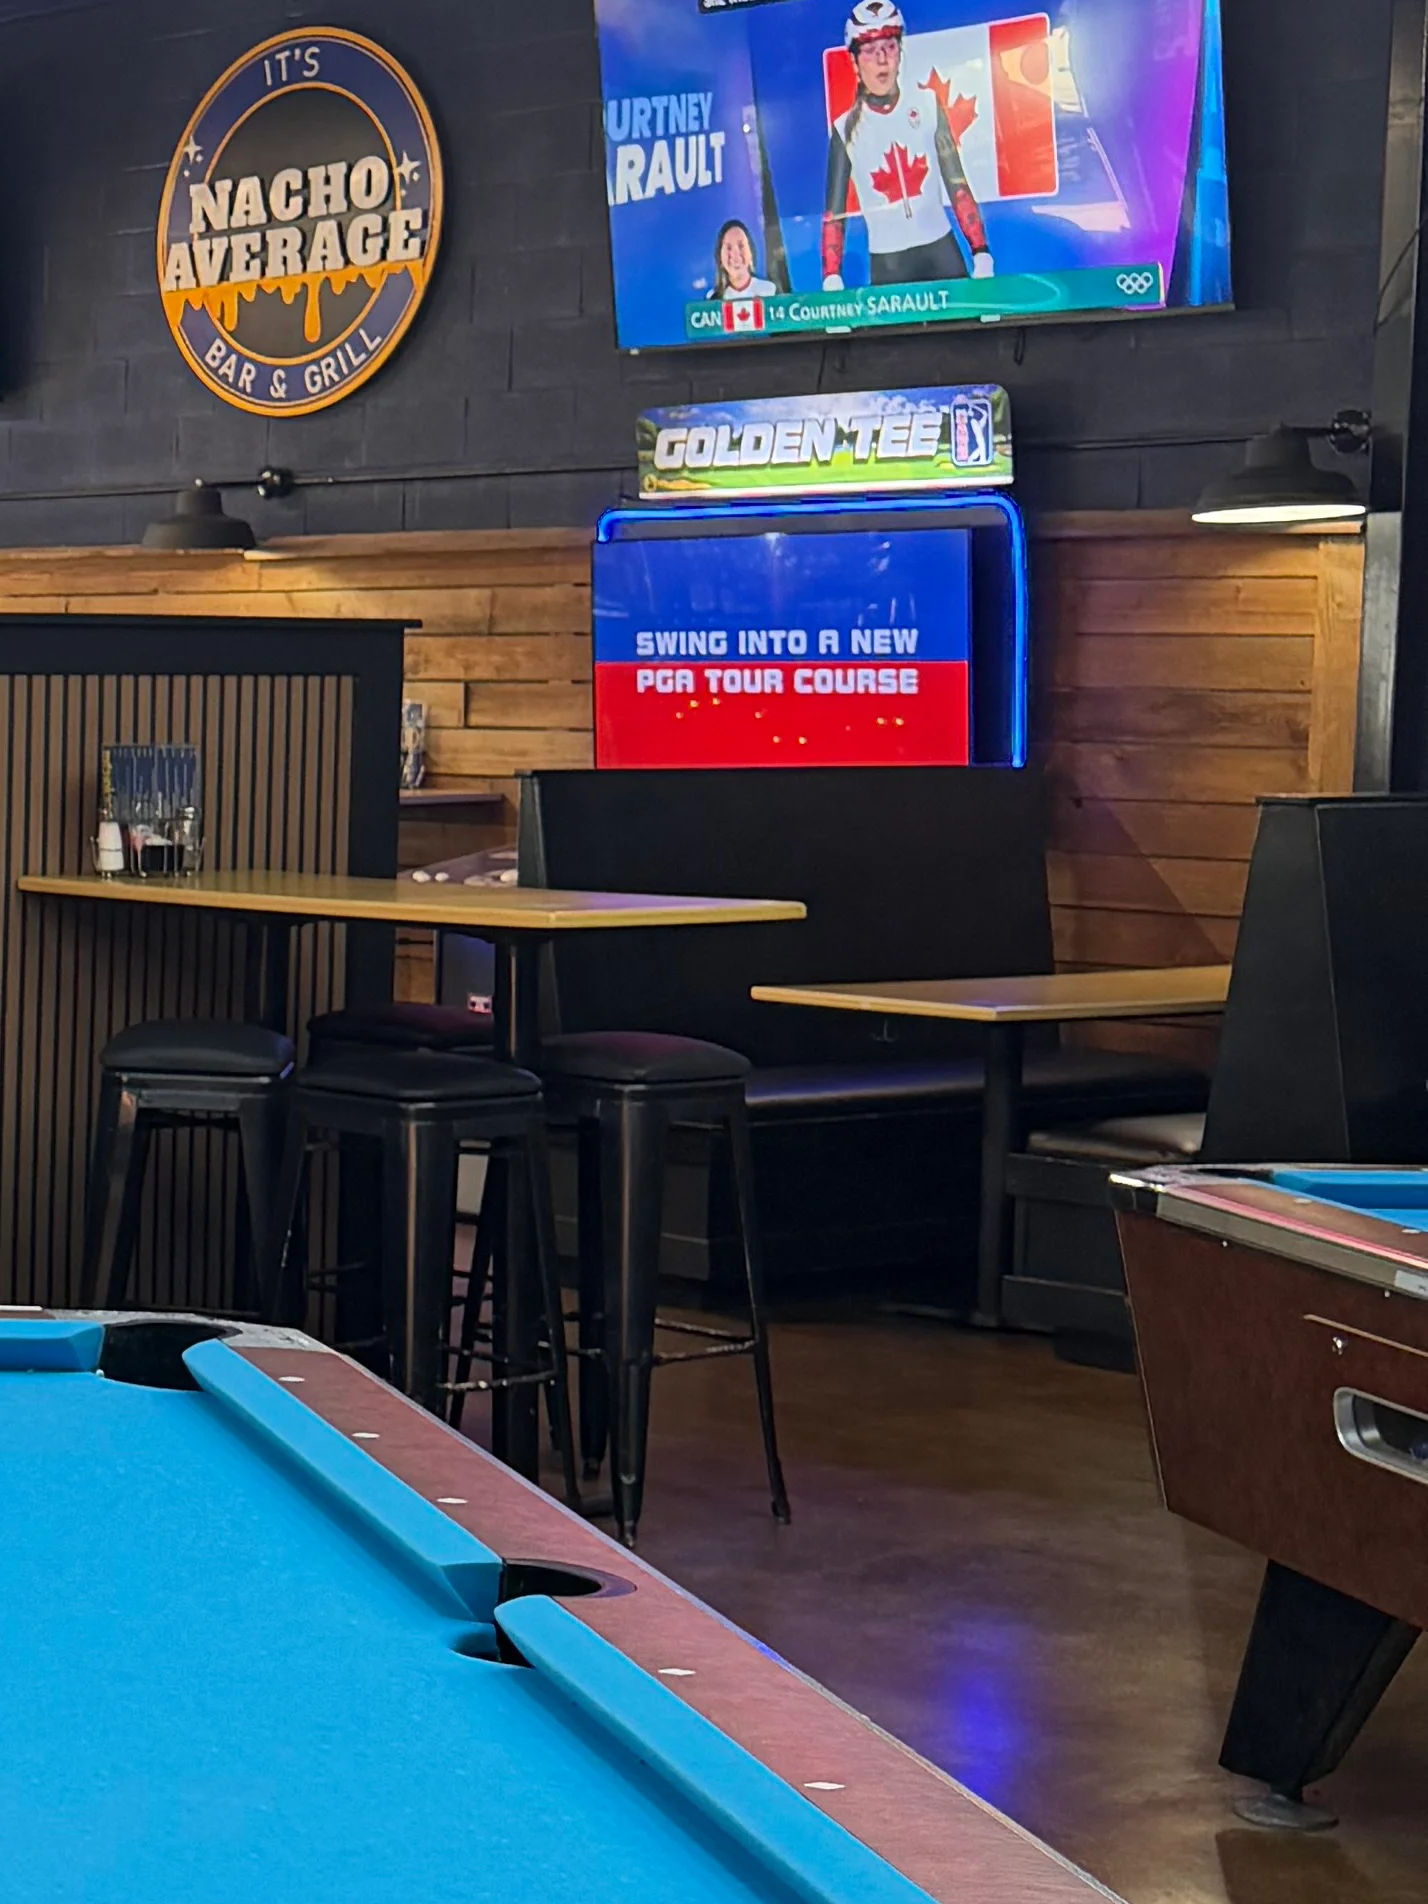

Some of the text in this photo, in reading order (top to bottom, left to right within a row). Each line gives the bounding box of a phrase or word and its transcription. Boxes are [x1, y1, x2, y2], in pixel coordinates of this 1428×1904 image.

[264, 46, 320, 86] IT'S
[190, 154, 389, 234] NACHO
[163, 207, 423, 292] AVERAGE
[690, 309, 723, 329] CAN
[768, 306, 785, 321] 14
[866, 290, 949, 315] SARAULT
[205, 327, 383, 399] BAR & GRILL
[654, 416, 836, 470] GOLDEN
[846, 411, 942, 462] TEE
[636, 628, 919, 656] SWING INTO A NEW
[636, 668, 919, 695] PGA TOUR COURSE
